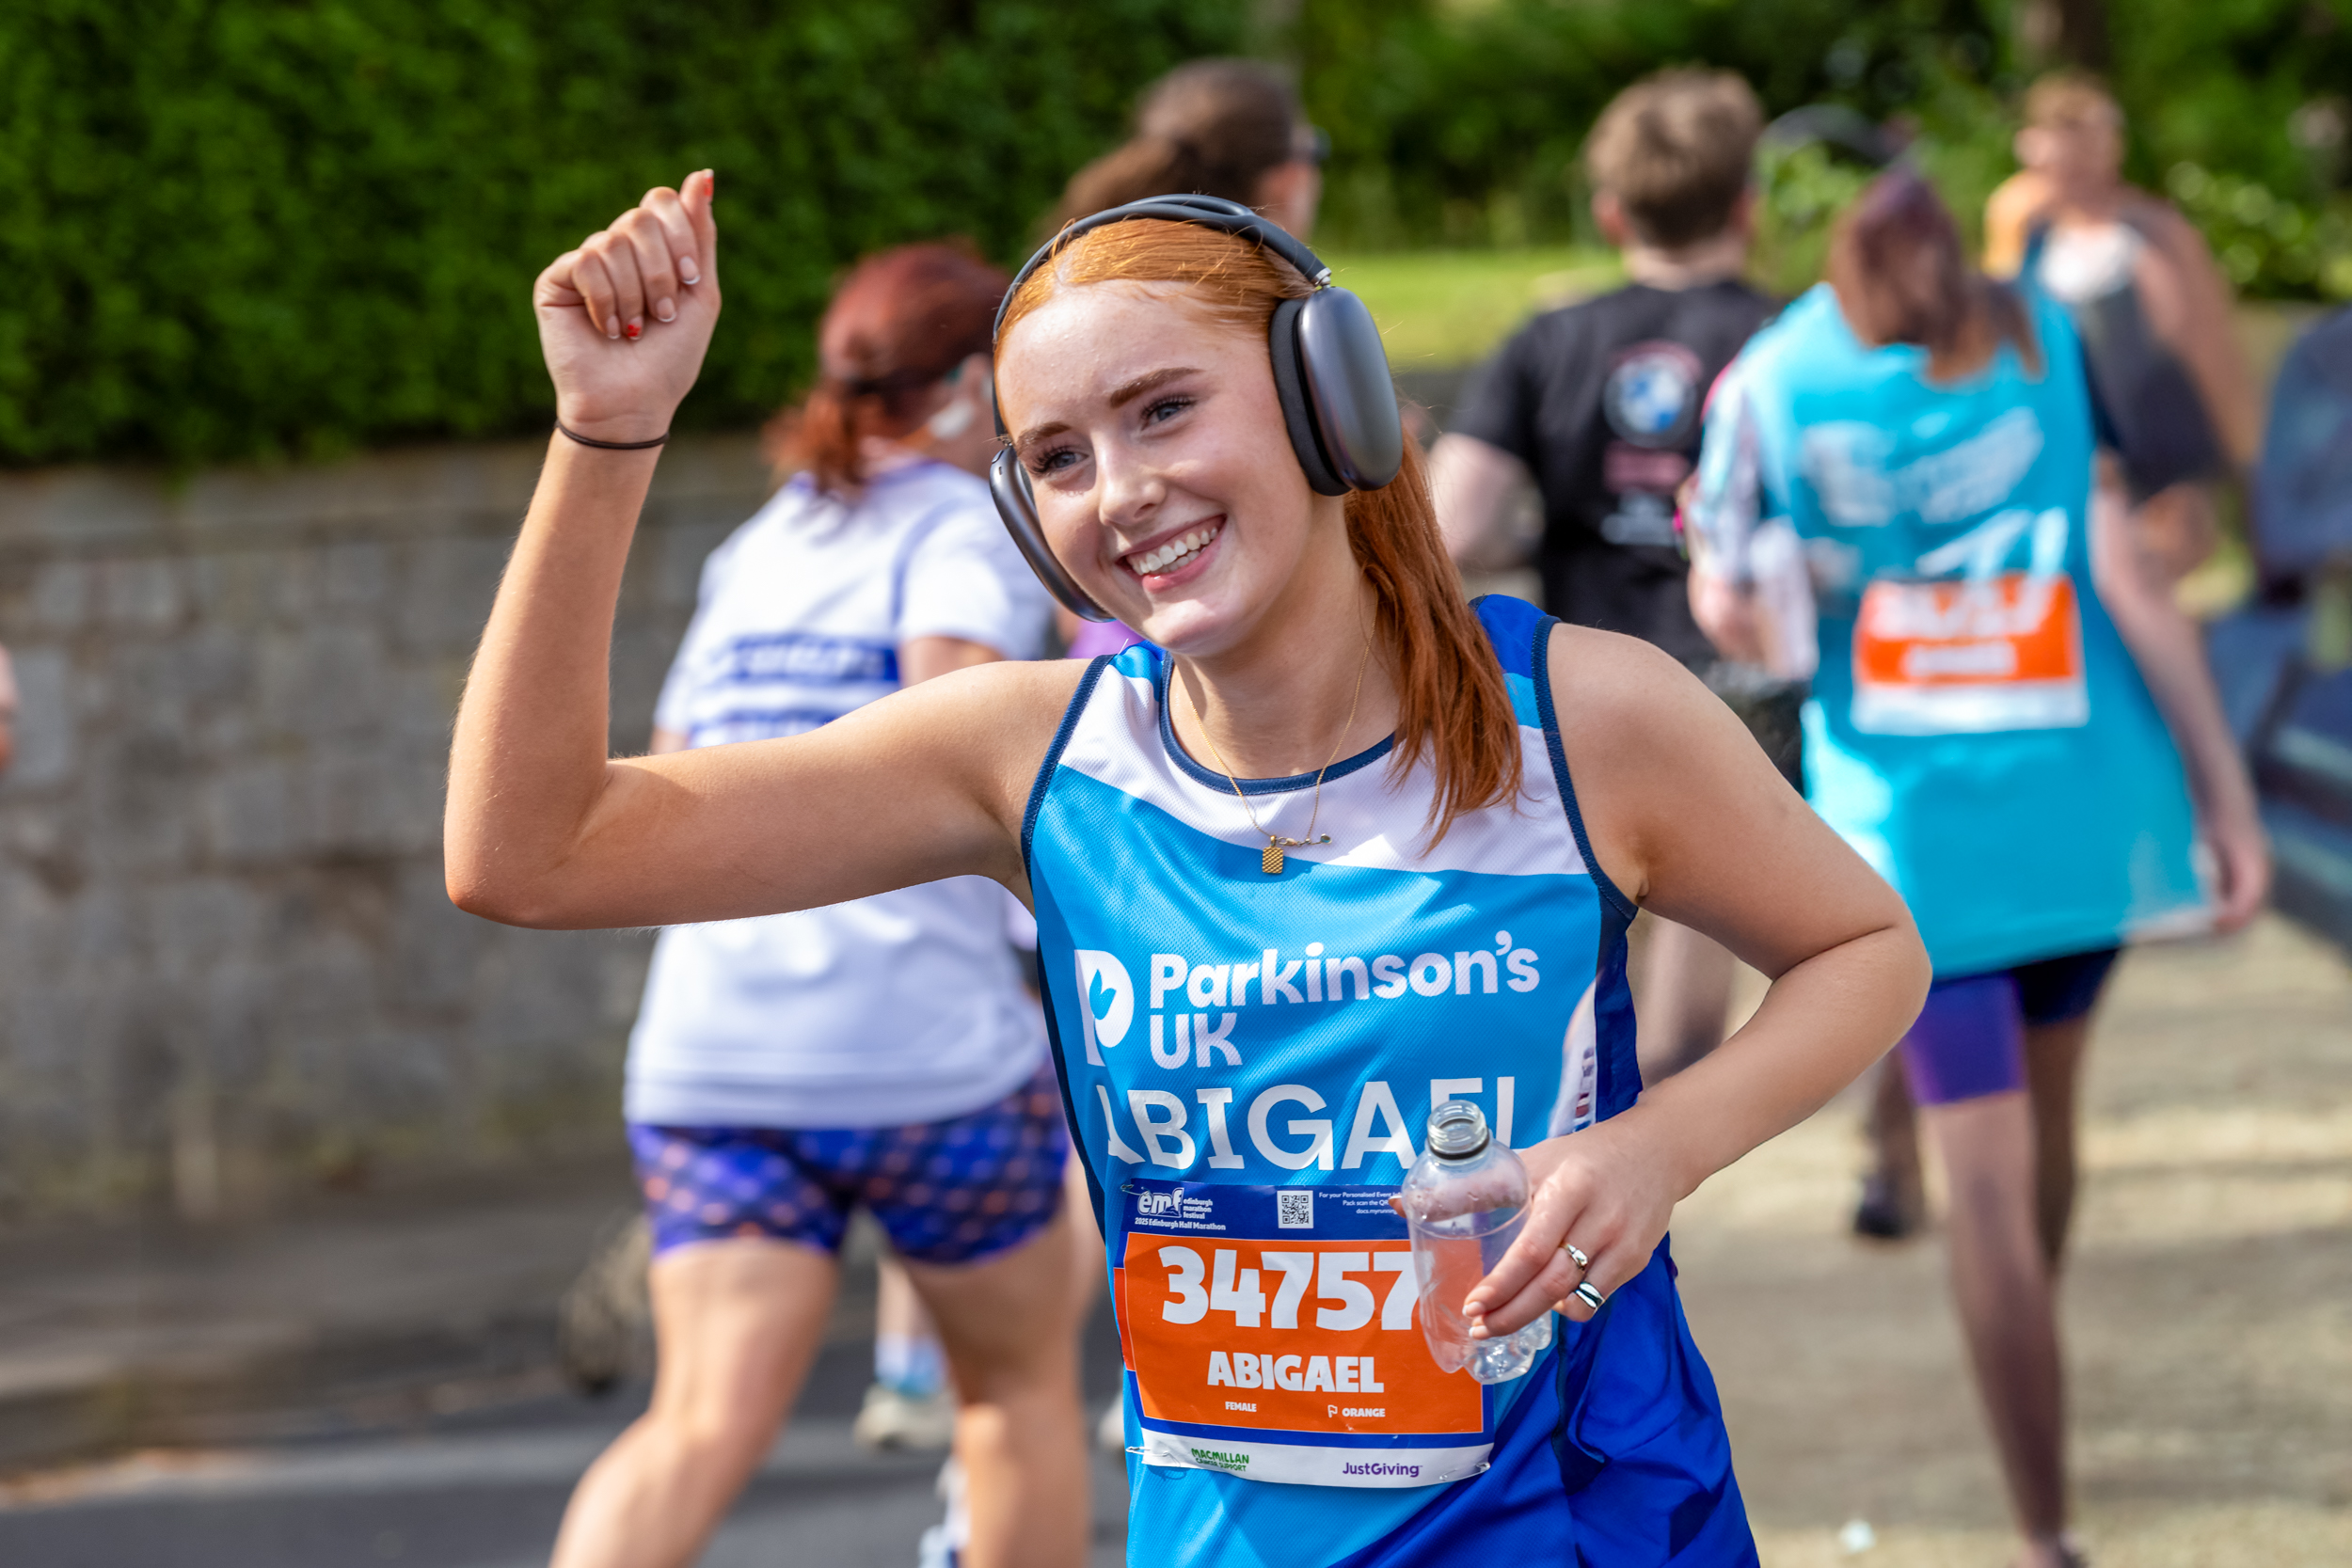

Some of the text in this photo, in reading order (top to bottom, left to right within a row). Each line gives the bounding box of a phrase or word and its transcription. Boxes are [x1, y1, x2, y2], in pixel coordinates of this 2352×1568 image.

[1150, 930, 1540, 1009] Parkinson's
[1150, 1012, 1243, 1069] UK
[1183, 1197, 1213, 1207] edinburgh
[1149, 1218, 1178, 1229] Edinburgh
[1179, 1221, 1192, 1229] Half
[1193, 1221, 1226, 1230] Marathon
[1158, 1245, 1435, 1331] 34757
[1207, 1351, 1384, 1393] ABIGAEL
[1225, 1402, 1257, 1412] FEMALE
[1342, 1407, 1386, 1418] ORANGE
[1191, 1448, 1249, 1464] MACMILLAN
[1219, 1462, 1247, 1471] SUPPORT
[1343, 1462, 1420, 1478] JustGiving
